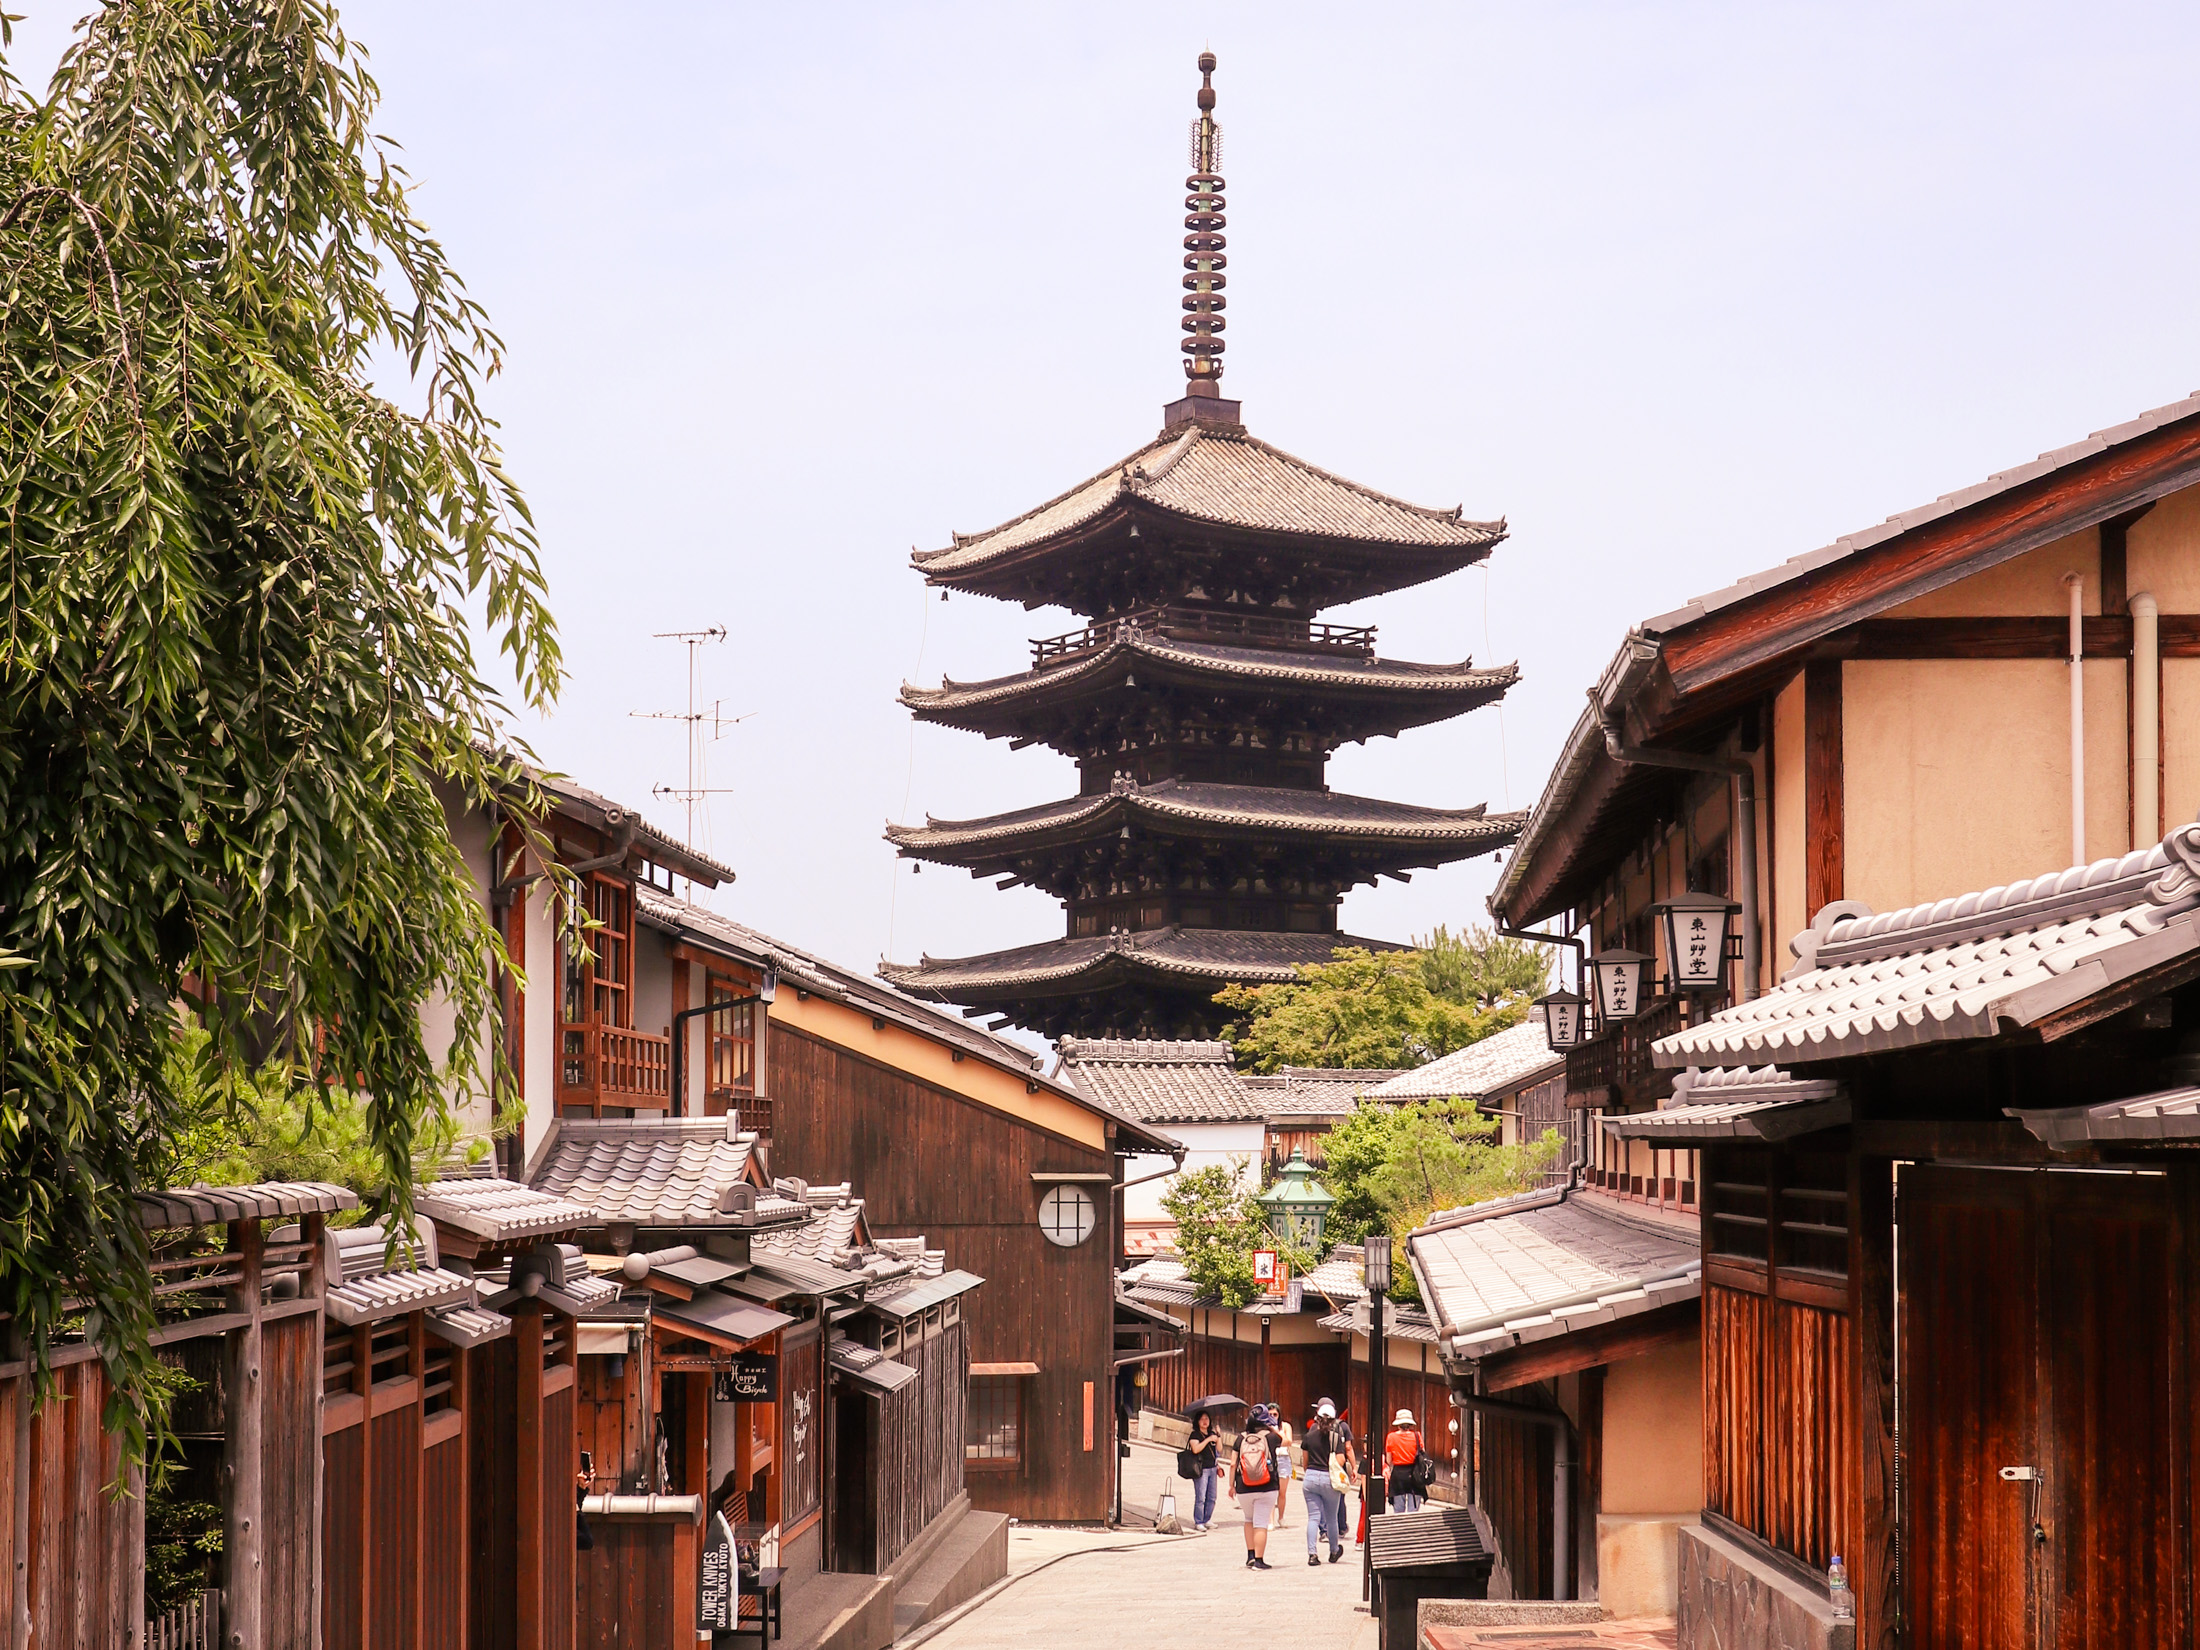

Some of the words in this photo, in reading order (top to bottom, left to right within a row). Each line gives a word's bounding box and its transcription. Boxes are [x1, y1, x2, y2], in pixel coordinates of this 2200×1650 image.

[1688, 917, 1708, 975] 東山艸堂
[1260, 1263, 1269, 1276] 氷
[731, 1364, 757, 1385] Happy
[736, 1384, 768, 1396] Bicycle
[702, 1551, 719, 1586] KNIVES
[718, 1543, 729, 1569] KYOTO
[718, 1572, 728, 1598] TOKYO
[702, 1590, 718, 1621] TOWER
[717, 1601, 727, 1628] OSAKA
